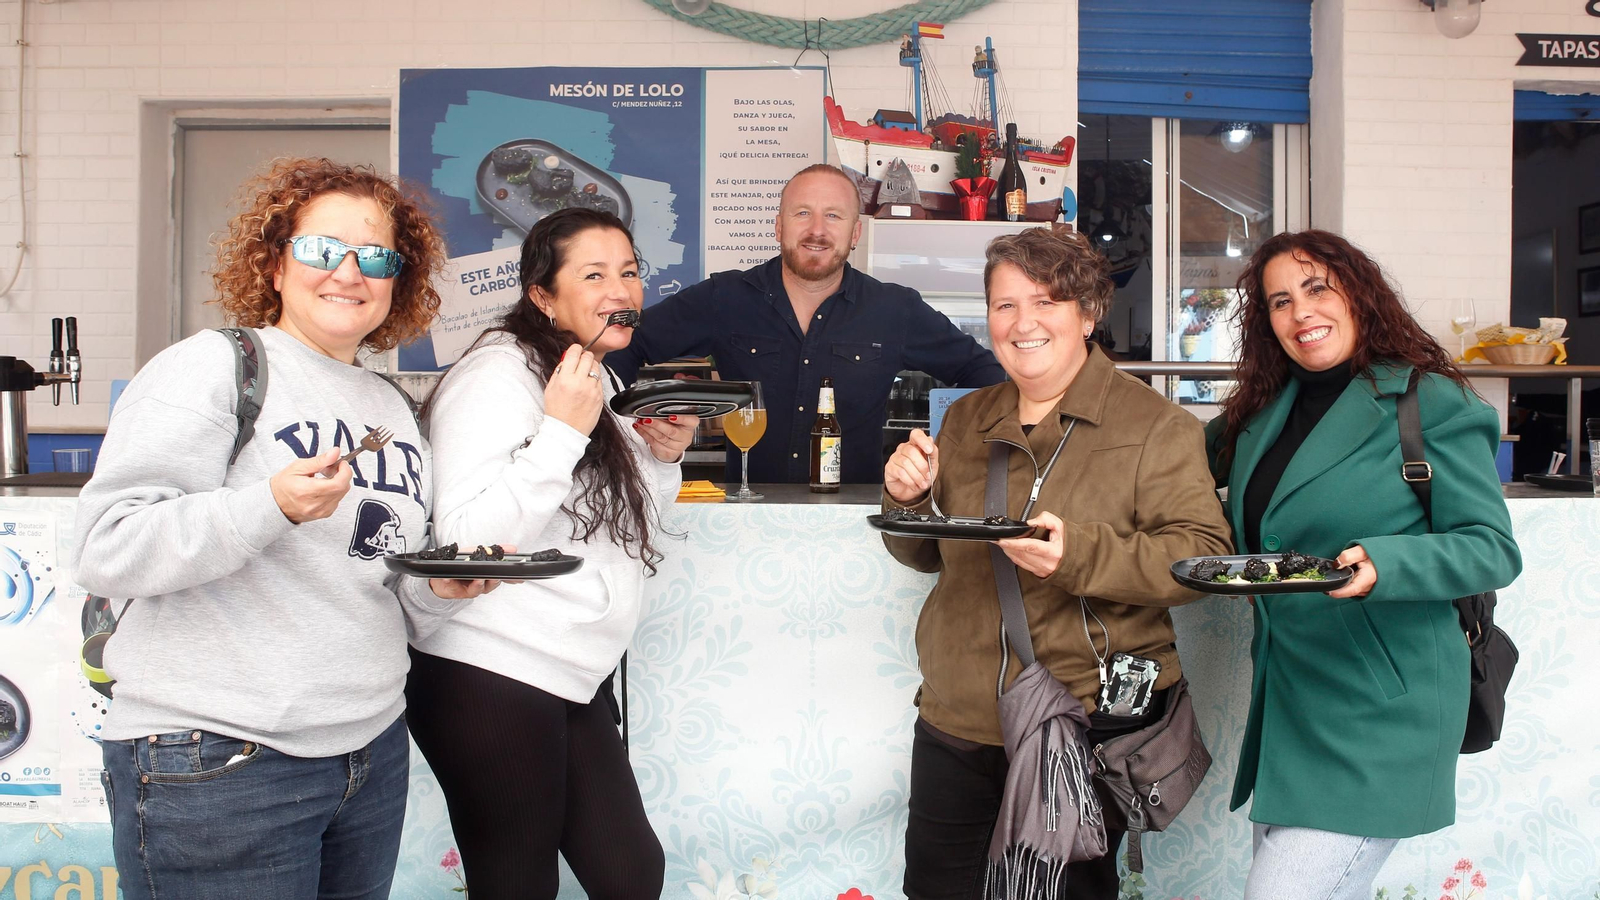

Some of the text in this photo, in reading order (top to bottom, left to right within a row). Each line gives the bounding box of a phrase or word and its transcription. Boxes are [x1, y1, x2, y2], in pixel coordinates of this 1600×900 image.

[1538, 40, 1600, 58] TAPAS
[550, 81, 684, 97] MESÓN DE LOLO
[461, 268, 491, 284] ESTE
[442, 312, 468, 324] Bacalao
[470, 308, 478, 318] de
[444, 323, 460, 333] tinta
[464, 320, 470, 329] de
